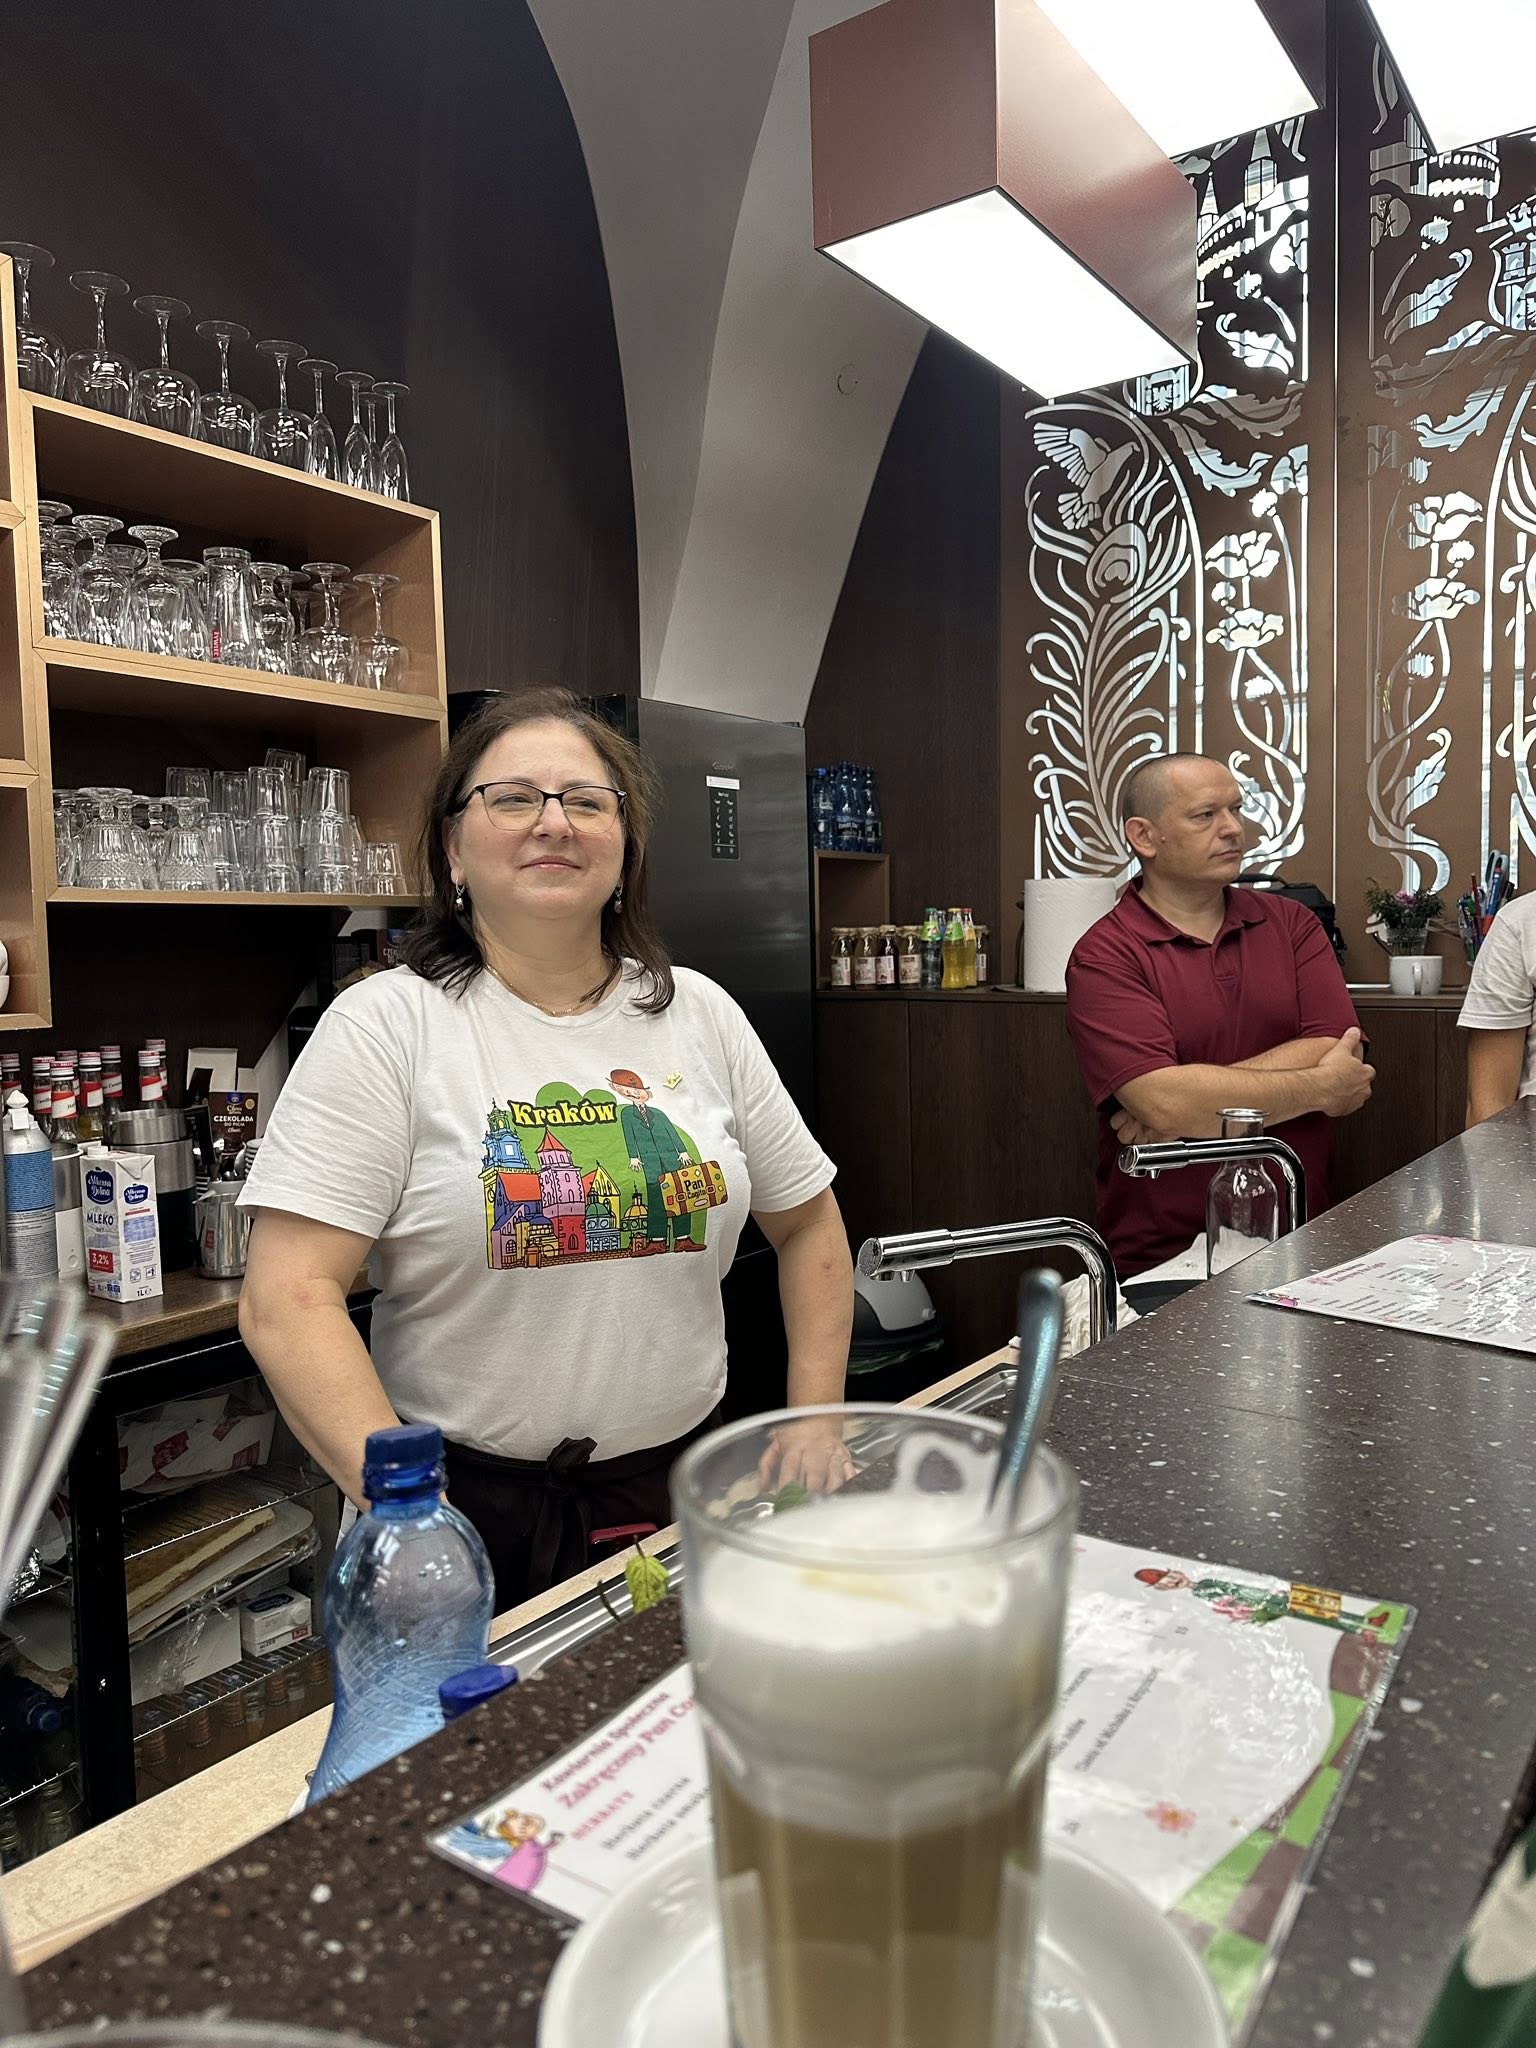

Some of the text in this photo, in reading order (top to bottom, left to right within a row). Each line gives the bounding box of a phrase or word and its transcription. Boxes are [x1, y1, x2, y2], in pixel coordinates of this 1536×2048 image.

[213, 1115, 254, 1123] CZEKOLADA
[508, 1099, 617, 1127] Kraków
[684, 1180, 704, 1191] Pan
[86, 1213, 114, 1226] MLEKO
[91, 1252, 110, 1266] 3,2%
[639, 1716, 676, 1743] Pan
